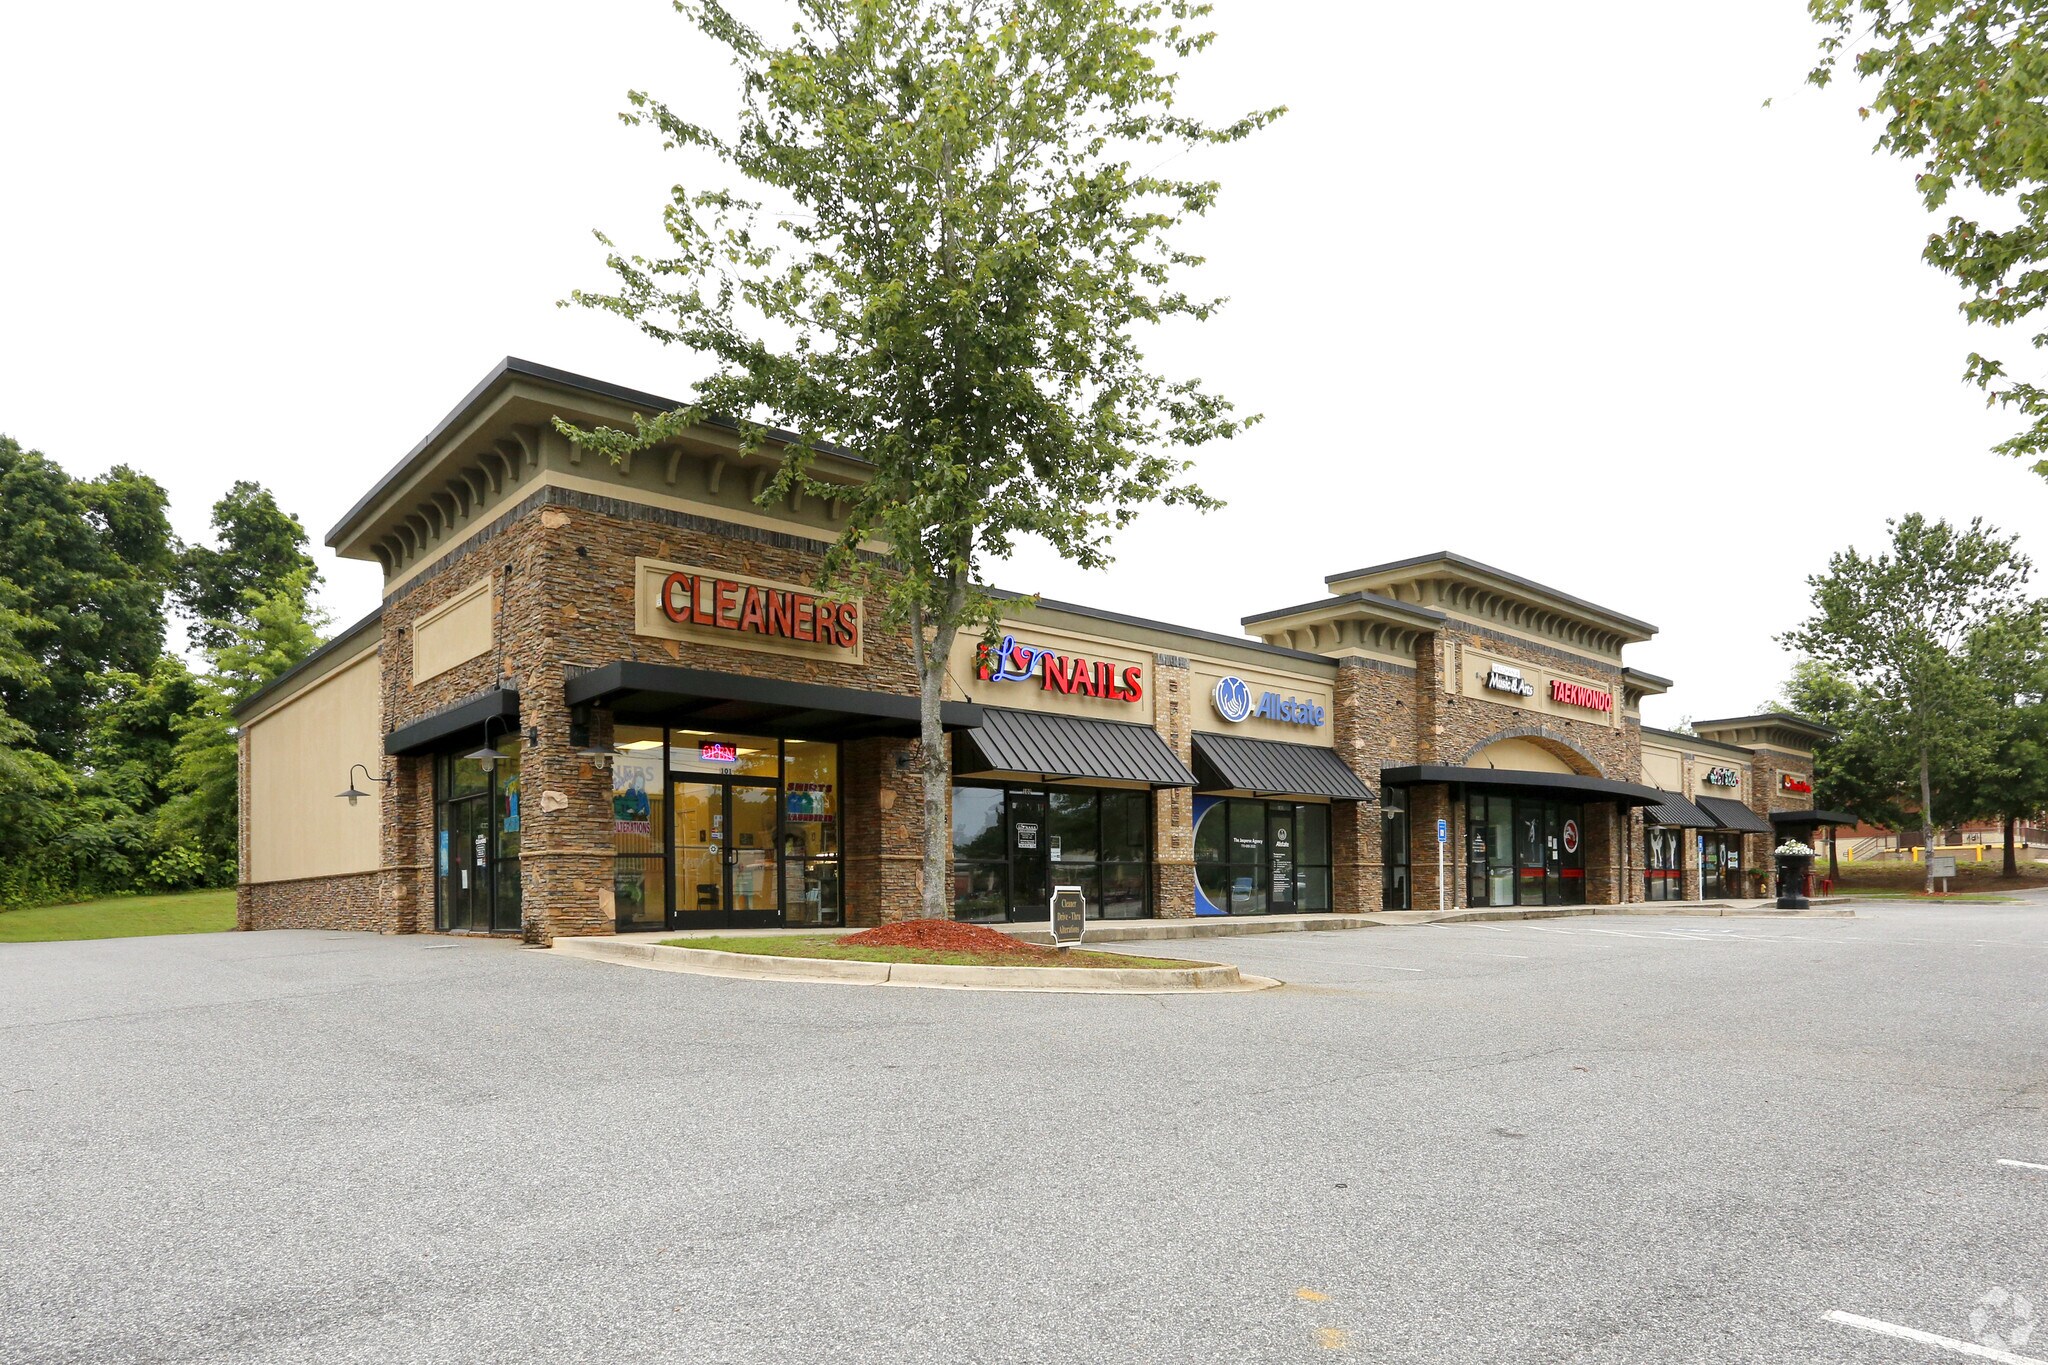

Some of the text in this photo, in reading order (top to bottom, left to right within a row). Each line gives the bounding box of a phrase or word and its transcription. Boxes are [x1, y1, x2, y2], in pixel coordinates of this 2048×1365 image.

[662, 572, 858, 648] CLEANERS
[1041, 653, 1143, 702] NAILS
[1488, 671, 1534, 696] Music & Arts
[1255, 692, 1325, 727] Allstate
[1552, 680, 1612, 713] TAEKWONDO
[702, 745, 735, 761] OPEN
[787, 783, 833, 793] SHIRTS
